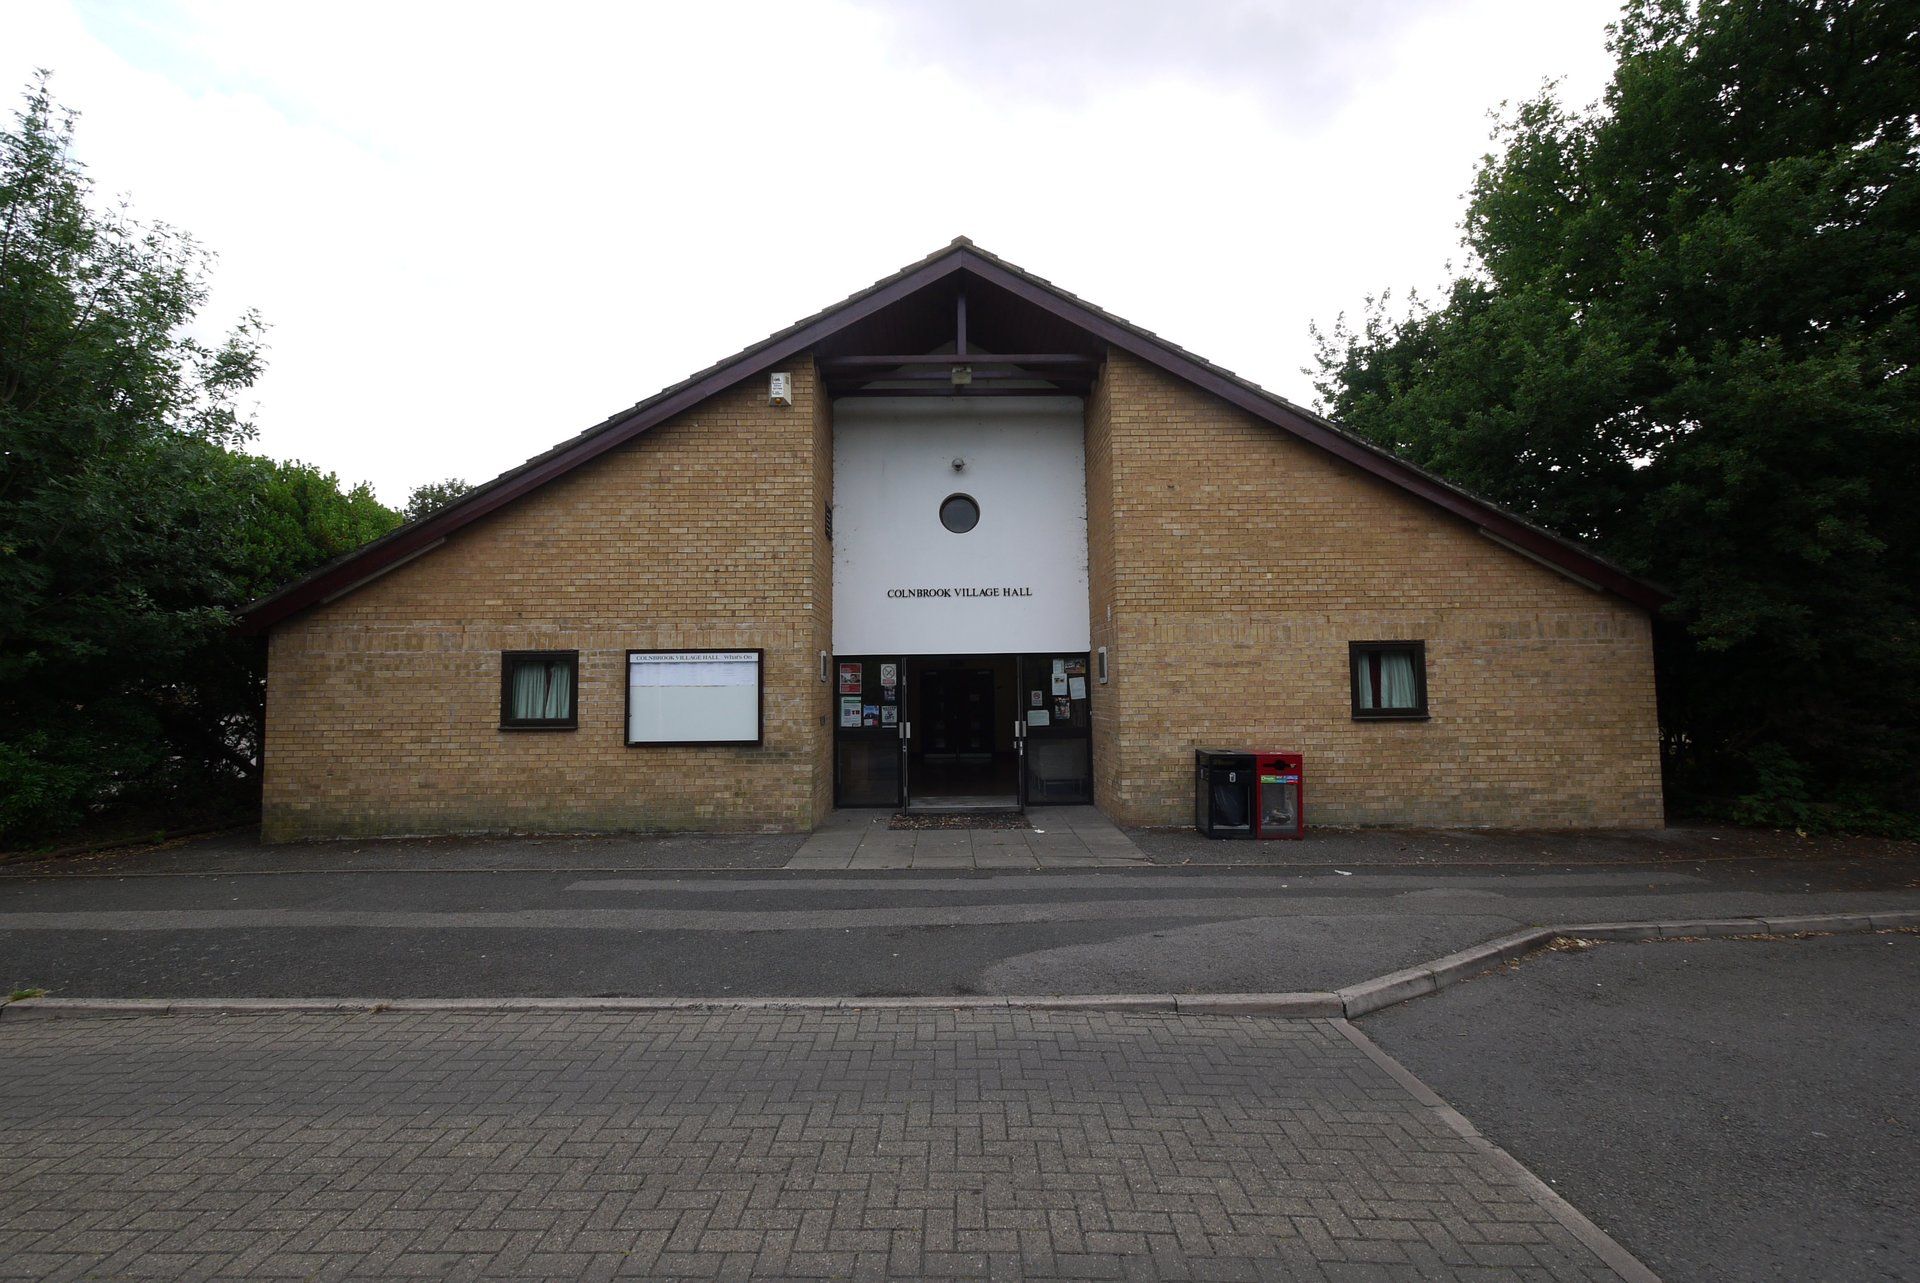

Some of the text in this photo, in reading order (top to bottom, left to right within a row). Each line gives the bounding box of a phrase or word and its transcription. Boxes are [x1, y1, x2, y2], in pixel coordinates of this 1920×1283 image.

[887, 587, 1033, 598] COLNBROOK VILLAGE HALL
